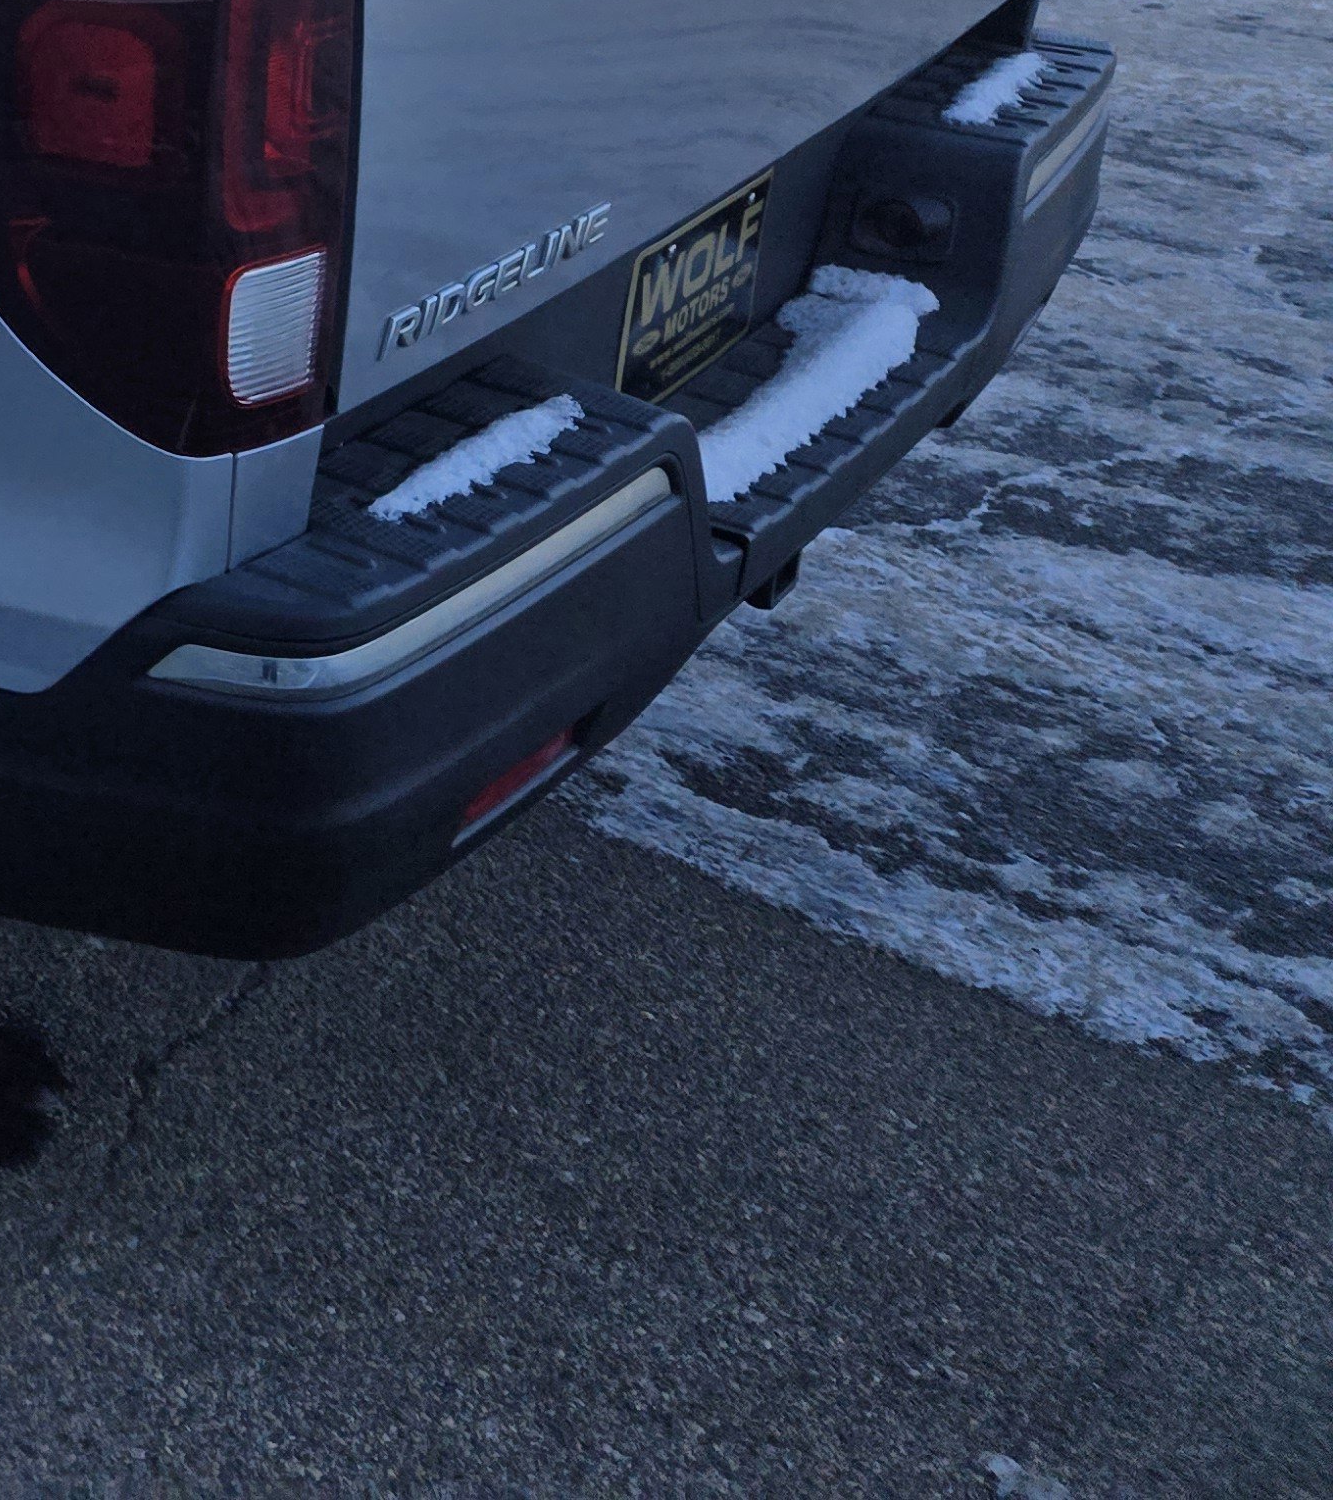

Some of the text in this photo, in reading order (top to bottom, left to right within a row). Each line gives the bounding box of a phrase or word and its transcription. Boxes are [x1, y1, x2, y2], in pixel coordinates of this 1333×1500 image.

[377, 201, 612, 361] RIDGELINE
[641, 198, 764, 328] WOLF
[663, 277, 731, 345] MOTORS
